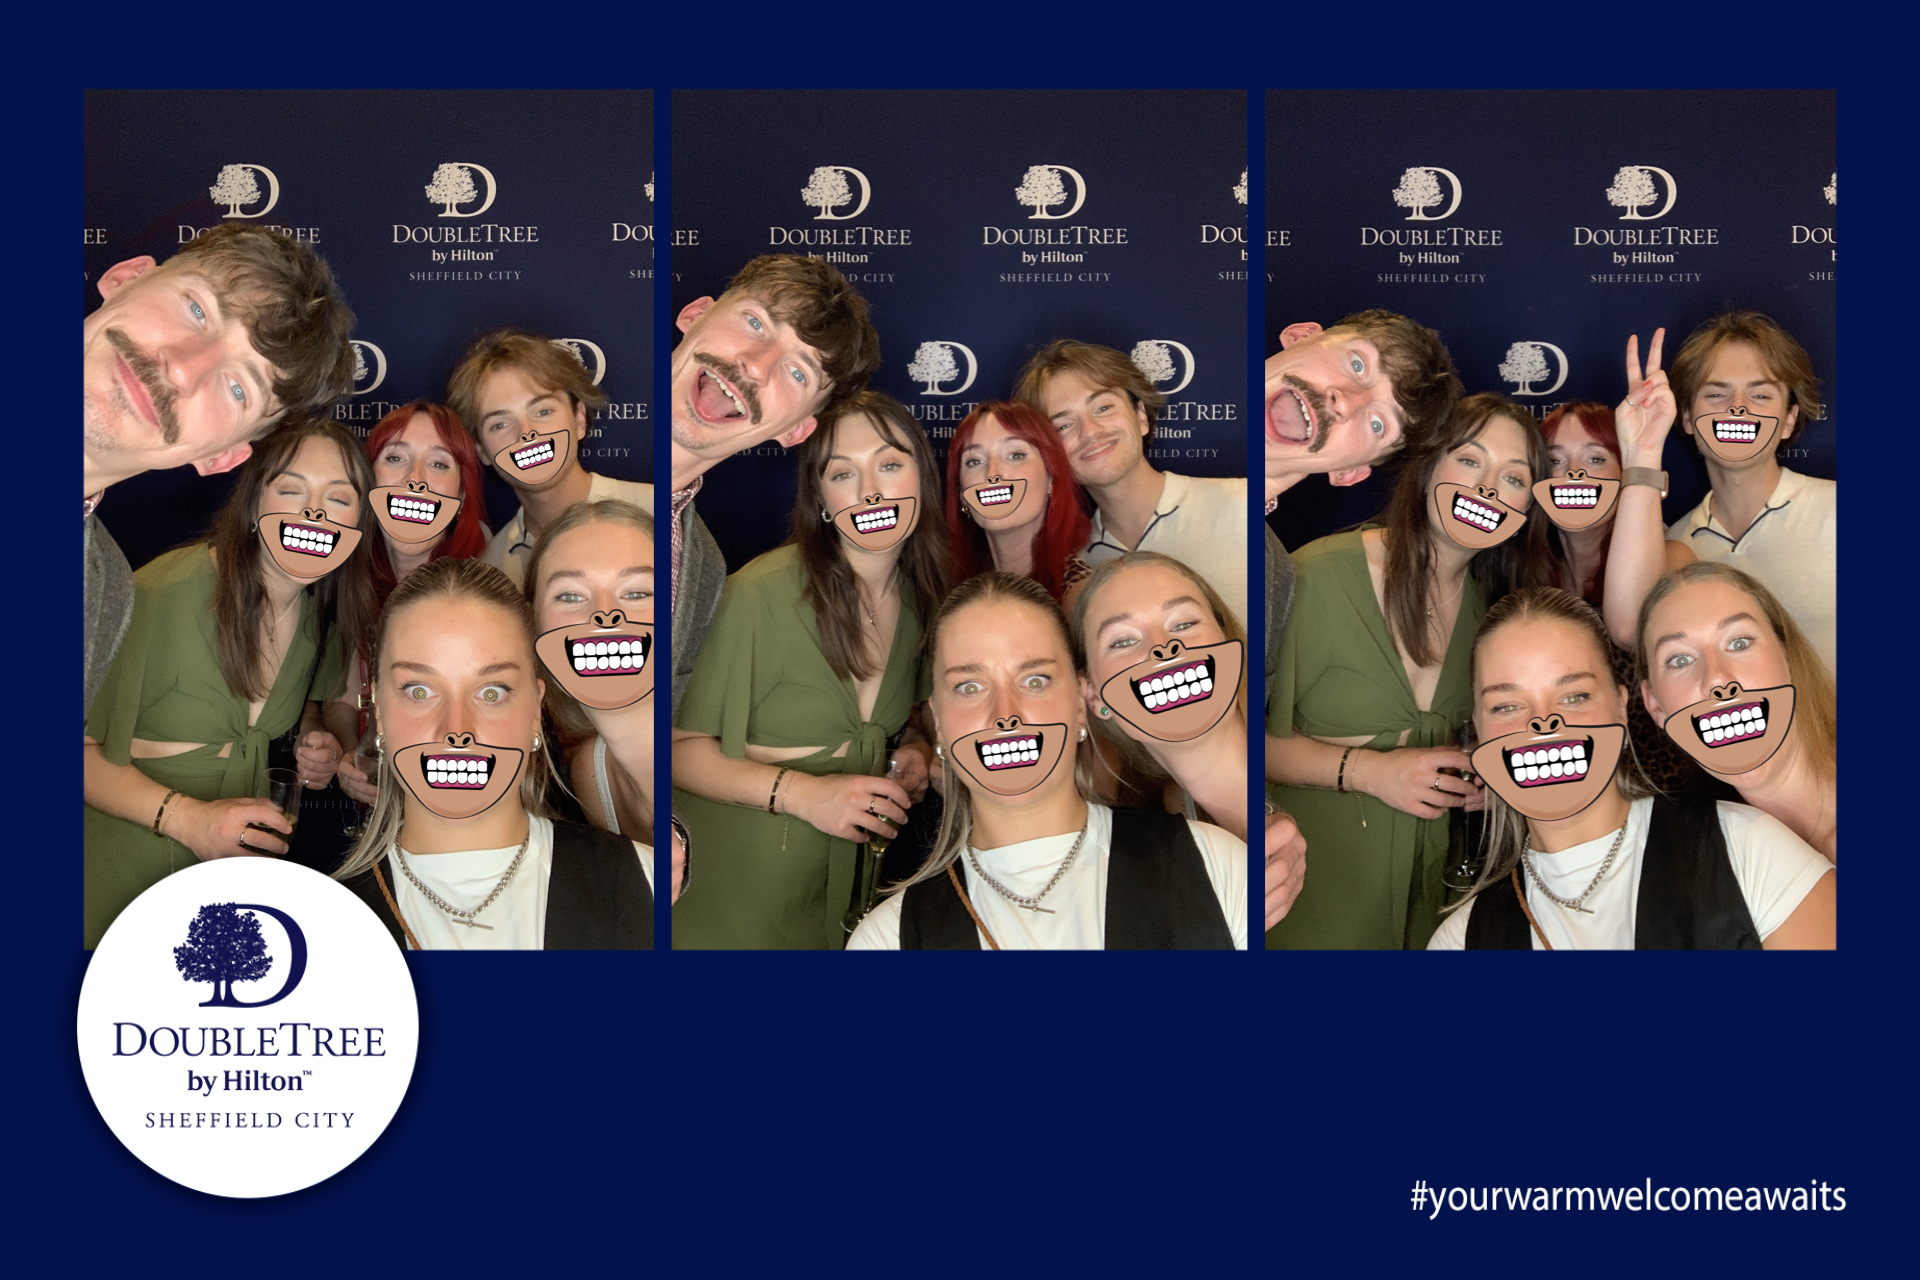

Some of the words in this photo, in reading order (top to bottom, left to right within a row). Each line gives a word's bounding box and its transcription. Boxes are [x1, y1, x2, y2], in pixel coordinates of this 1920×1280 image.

[432, 249, 448, 264] by
[1022, 251, 1038, 266] by
[1399, 252, 1415, 267] by
[1613, 251, 1629, 267] by
[409, 271, 483, 281] SHEFFIELD
[488, 270, 522, 280] CITY
[863, 273, 895, 282] CITY
[1000, 273, 1073, 282] SHEFFIELD
[1078, 272, 1111, 282] CITY
[1377, 273, 1449, 283] SHEFFIELD
[1454, 273, 1486, 283] CITY
[1590, 273, 1664, 283] SHEFFIELD
[1669, 273, 1702, 282] CITY
[597, 448, 630, 458] CITY
[757, 447, 789, 457] CITY
[1186, 448, 1219, 458] CITY
